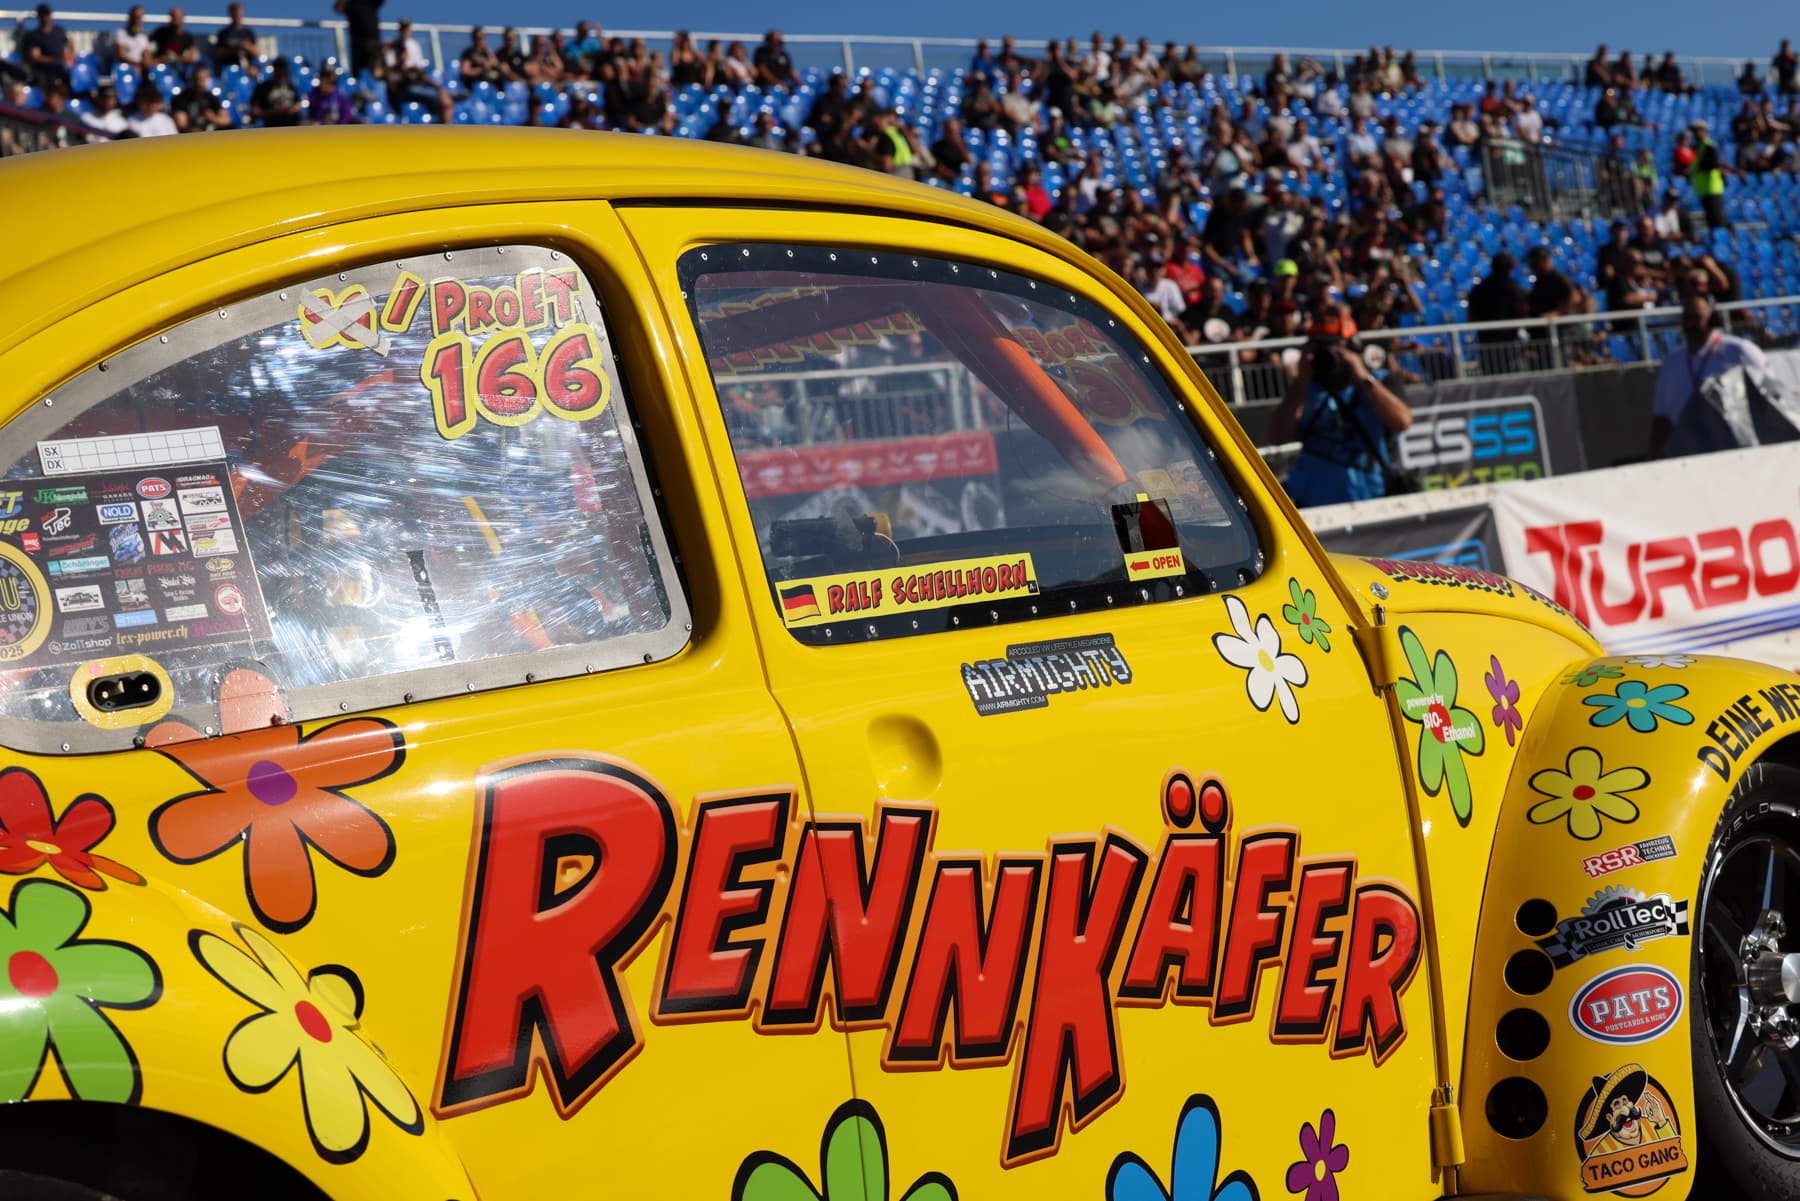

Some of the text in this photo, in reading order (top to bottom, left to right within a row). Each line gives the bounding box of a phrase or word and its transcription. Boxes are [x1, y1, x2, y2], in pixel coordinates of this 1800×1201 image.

[430, 332, 604, 429] 166
[44, 446, 59, 456] SX
[47, 458, 62, 470] DX
[141, 483, 166, 493] PATS
[103, 505, 131, 518] NOLD
[1152, 553, 1182, 571] OPEN
[1526, 516, 1800, 630] TURBO
[826, 559, 1028, 615] RALF SCHELLHORN
[0, 647, 23, 658] 025
[1008, 645, 1041, 657] AIRCOOLED
[1050, 639, 1079, 651] LIFESTYLE
[963, 646, 1130, 701] AIRMIGHTY
[977, 695, 1047, 713] WWW.AIRMIGHTY.COM
[1406, 693, 1444, 711] powered by
[1422, 711, 1443, 729] BIO-
[1442, 722, 1476, 742] Ethanol
[1696, 694, 1775, 783] DEINE
[1720, 802, 1770, 847] WELD
[1642, 843, 1673, 856] TECHNIK
[1585, 847, 1641, 875] RSR
[1573, 904, 1666, 940] RollTec
[434, 755, 1421, 1164] RENNKÄFER
[1588, 985, 1671, 1025] PATS
[1604, 1017, 1645, 1033] POSTCARDS
[1650, 1012, 1667, 1024] MORE
[1588, 1145, 1680, 1182] TACO GANG
